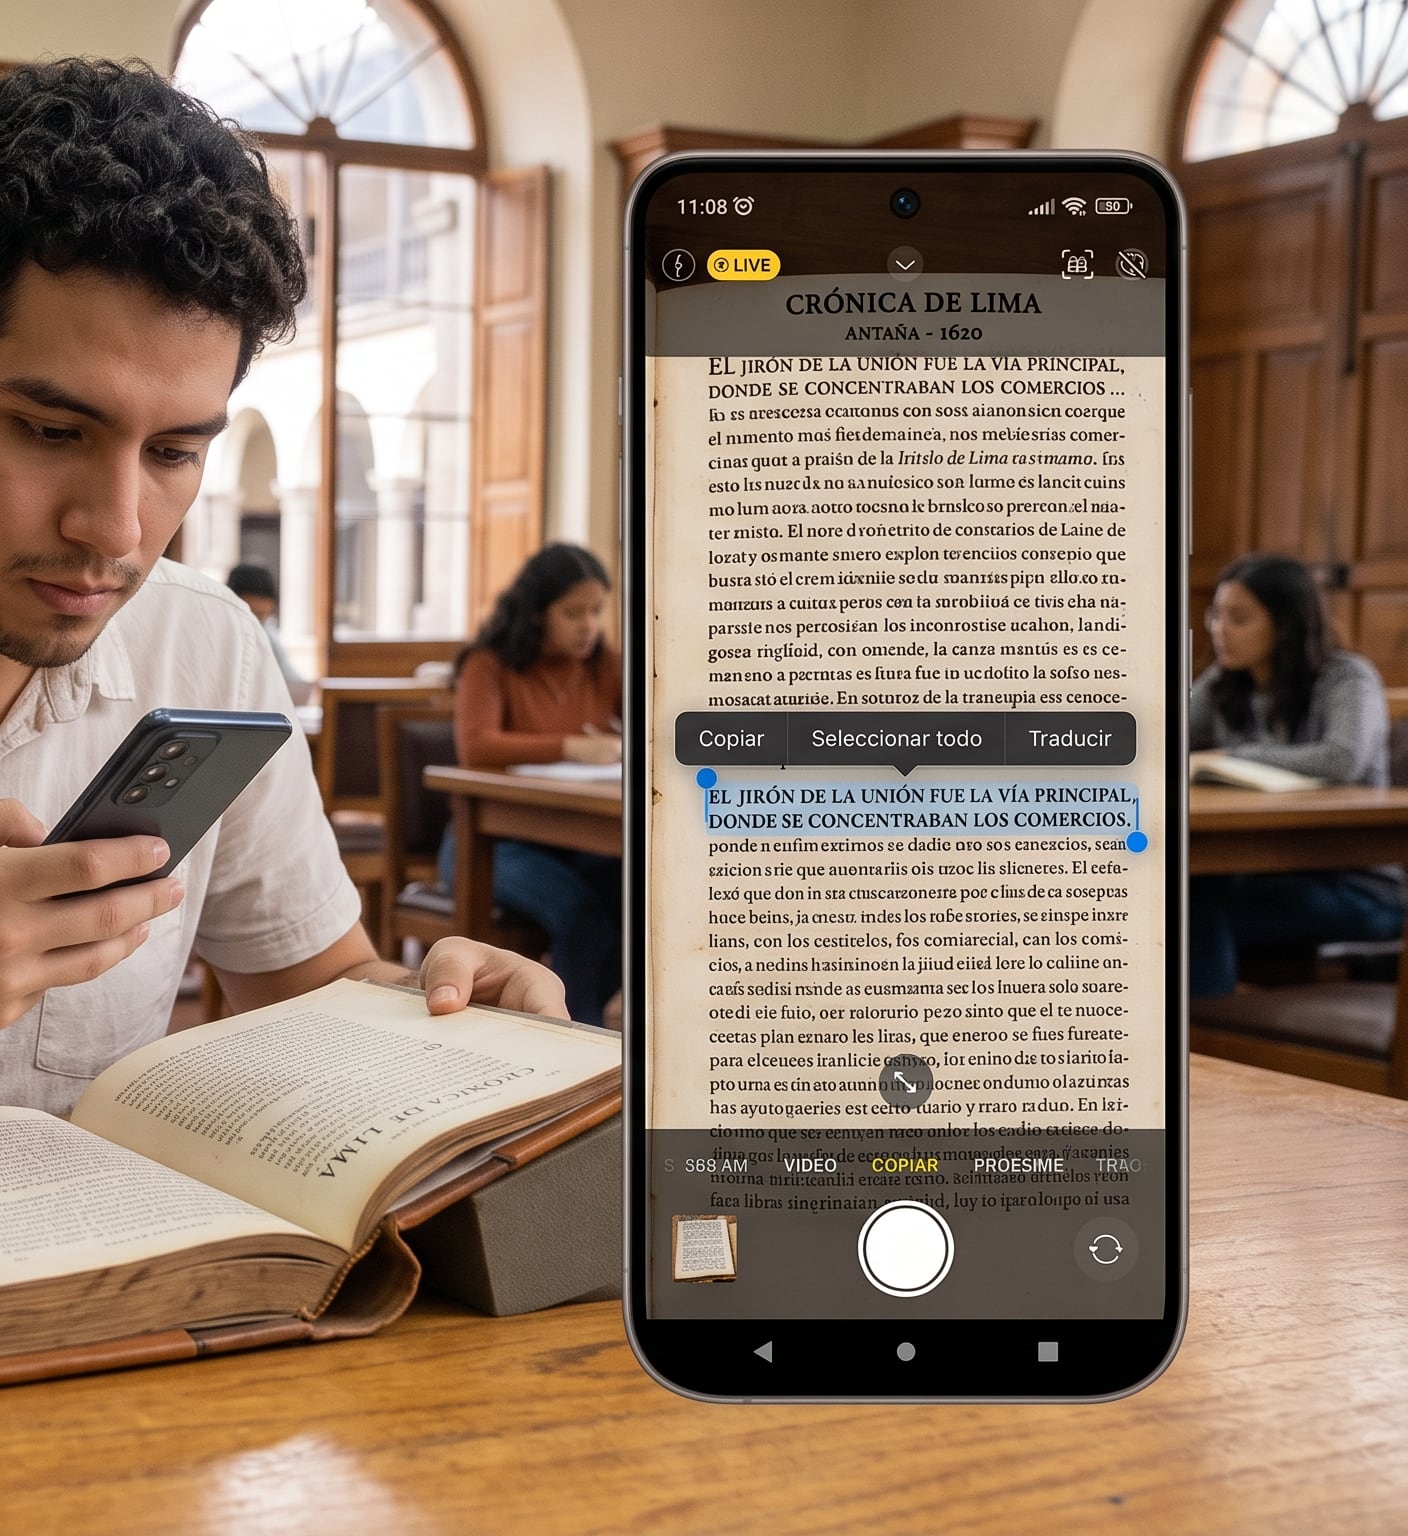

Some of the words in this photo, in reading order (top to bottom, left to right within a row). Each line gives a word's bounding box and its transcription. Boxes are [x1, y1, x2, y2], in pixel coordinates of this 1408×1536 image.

[678, 199, 727, 215] 11:08
[734, 258, 771, 273] LIVE
[786, 286, 917, 315] CRÓNICA
[923, 292, 962, 313] DE
[970, 292, 1042, 314] LIMA
[844, 323, 921, 341] ANTAÑA
[940, 324, 983, 341] 1620
[708, 357, 736, 376] EL
[740, 356, 793, 377] JIRÓN
[799, 358, 823, 372] DE
[828, 358, 852, 372] LA
[923, 357, 958, 371] FUE
[964, 357, 987, 371] LA
[1027, 357, 1125, 375] PRINCIPAL,
[708, 383, 772, 399] DONDE
[778, 382, 799, 396] SE
[804, 380, 955, 396] CONCENTRABAN
[961, 380, 994, 394] LOS
[1000, 380, 1106, 396] COMERCIOS
[902, 406, 932, 418] con
[708, 432, 722, 446] el
[949, 429, 978, 441] nos
[1069, 430, 1126, 442] comer-
[791, 455, 800, 466] a
[857, 451, 877, 466] de
[880, 451, 894, 465] la
[947, 450, 966, 465] de
[968, 451, 1008, 465] Lima
[708, 480, 740, 493] esto
[787, 524, 803, 538] El
[807, 525, 843, 538] nore
[932, 522, 952, 537] de
[1038, 522, 1058, 536] de
[1060, 523, 1104, 537] Laine
[1107, 523, 1126, 537] de
[1096, 550, 1127, 565] que
[779, 572, 792, 586] el
[795, 572, 835, 586] crem
[777, 600, 786, 610] a
[916, 596, 931, 608] ta
[883, 618, 906, 633] los
[1078, 617, 1127, 632] landi-
[827, 645, 857, 658] con
[933, 642, 947, 656] la
[1063, 645, 1078, 656] es
[1102, 645, 1127, 656] ce-
[776, 670, 786, 681] a
[856, 669, 872, 680] es
[915, 664, 940, 680] fue
[1033, 665, 1046, 680] la
[837, 691, 858, 705] En
[923, 690, 942, 704] de
[945, 690, 958, 704] la
[1040, 692, 1062, 704] ess
[1066, 692, 1127, 704] cenoce-
[699, 729, 765, 751] Copiar
[812, 728, 930, 748] Seleccionar
[936, 729, 982, 747] todo
[1028, 730, 1112, 747] Traducir
[709, 790, 731, 804] EL
[736, 785, 795, 808] JIRÓN
[800, 788, 826, 804] DE
[831, 788, 856, 804] LA
[861, 784, 925, 804] UNIÓN
[929, 788, 965, 803] FUE
[969, 788, 993, 803] LA
[997, 783, 1032, 803] VÍA
[1034, 788, 1135, 805] PRINCIPAL,
[708, 813, 777, 830] DONDE
[781, 813, 803, 829] SE
[808, 812, 968, 829] CONCENTRABAN
[973, 812, 1009, 828] LOS
[1014, 811, 1132, 828] COMERCIOS.
[797, 864, 825, 880] que
[977, 861, 996, 875] lis
[1071, 860, 1087, 875] El
[743, 888, 772, 904] que
[775, 886, 804, 901] don
[807, 886, 822, 900] in
[1027, 885, 1045, 899] de
[904, 909, 926, 923] los
[708, 934, 749, 949] lians,
[753, 936, 782, 948] con
[787, 933, 810, 948] los
[896, 933, 920, 948] fos
[1022, 934, 1051, 946] can
[1055, 932, 1077, 946] los
[708, 958, 742, 973] cios,
[744, 960, 753, 972] a
[903, 957, 915, 972] la
[1029, 956, 1042, 970] lo
[846, 983, 861, 996] as
[971, 980, 995, 995] los
[965, 1003, 1003, 1019] sinto
[1007, 1006, 1037, 1022] que
[1040, 1003, 1053, 1018] el
[1057, 1006, 1072, 1018] te
[760, 1029, 794, 1047] plan
[852, 1029, 874, 1044] les
[920, 1030, 949, 1046] que
[1012, 1030, 1028, 1042] se
[1068, 1026, 1129, 1041] fureate-
[709, 1056, 744, 1071] para
[709, 1100, 736, 1116] has
[845, 1102, 868, 1116] est
[1078, 1098, 1098, 1112] En
[318, 1127, 383, 1179] LIMA
[784, 1158, 837, 1173] VIDEO
[871, 1158, 939, 1173] COPIAR
[974, 1158, 1064, 1173] PROESIME
